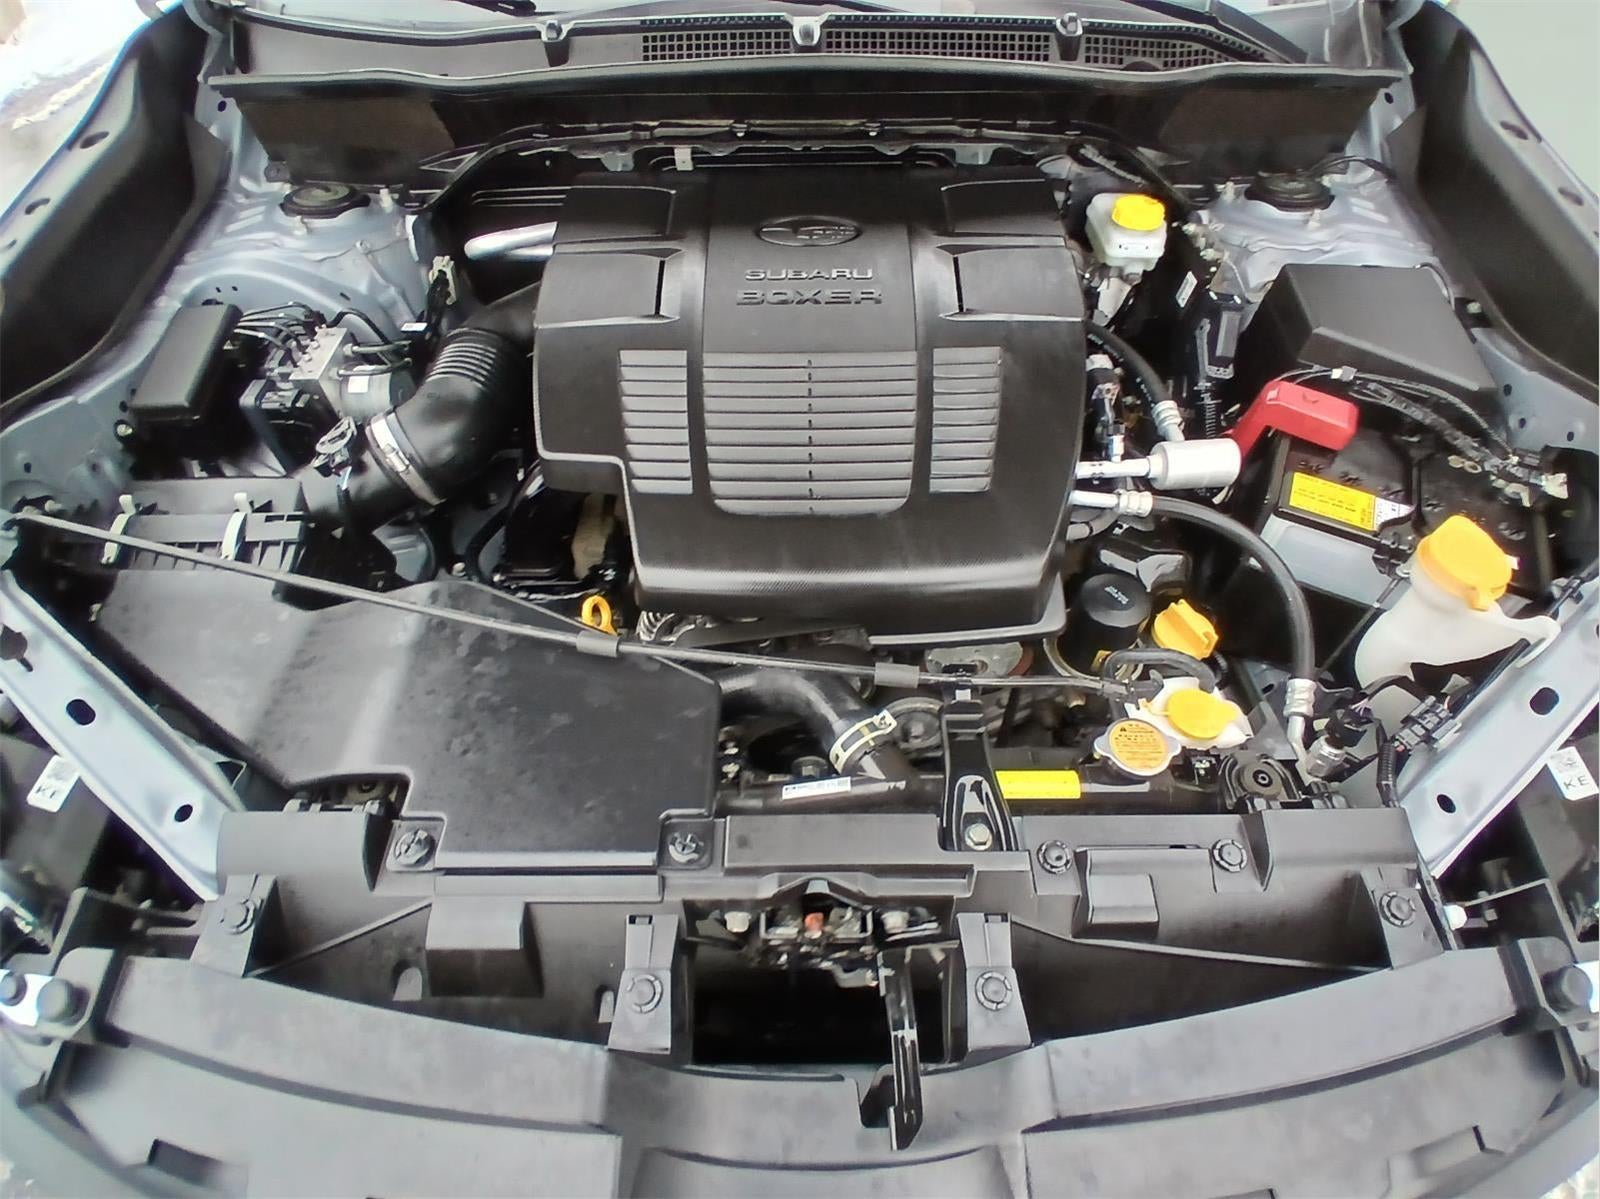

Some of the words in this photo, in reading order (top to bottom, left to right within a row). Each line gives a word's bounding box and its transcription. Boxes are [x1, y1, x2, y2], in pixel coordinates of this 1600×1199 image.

[745, 268, 873, 281] SUBARU
[736, 289, 882, 305] BOXER
[1563, 775, 1590, 790] KE
